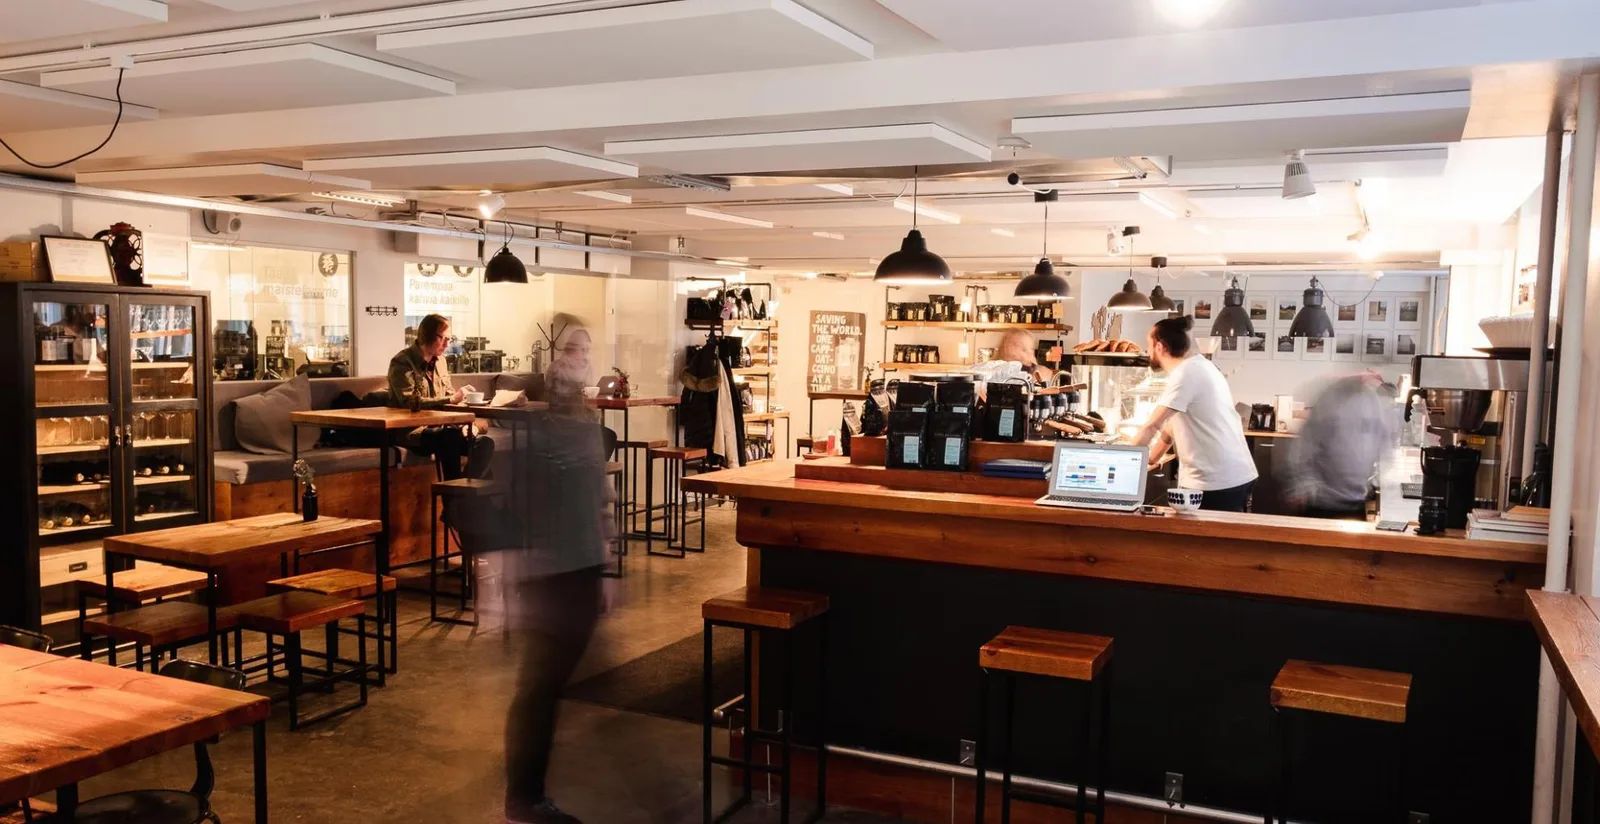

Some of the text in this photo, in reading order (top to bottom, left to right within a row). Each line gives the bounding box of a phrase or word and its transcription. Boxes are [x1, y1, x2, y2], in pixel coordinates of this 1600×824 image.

[815, 314, 847, 325] SAVING
[812, 324, 863, 336] THE WORLD.
[816, 334, 833, 344] ONE
[810, 344, 834, 354] CAPP-
[815, 354, 834, 364] OAT-
[811, 364, 836, 374] CCINO
[812, 374, 831, 384] AT A
[810, 383, 833, 393] TIME
